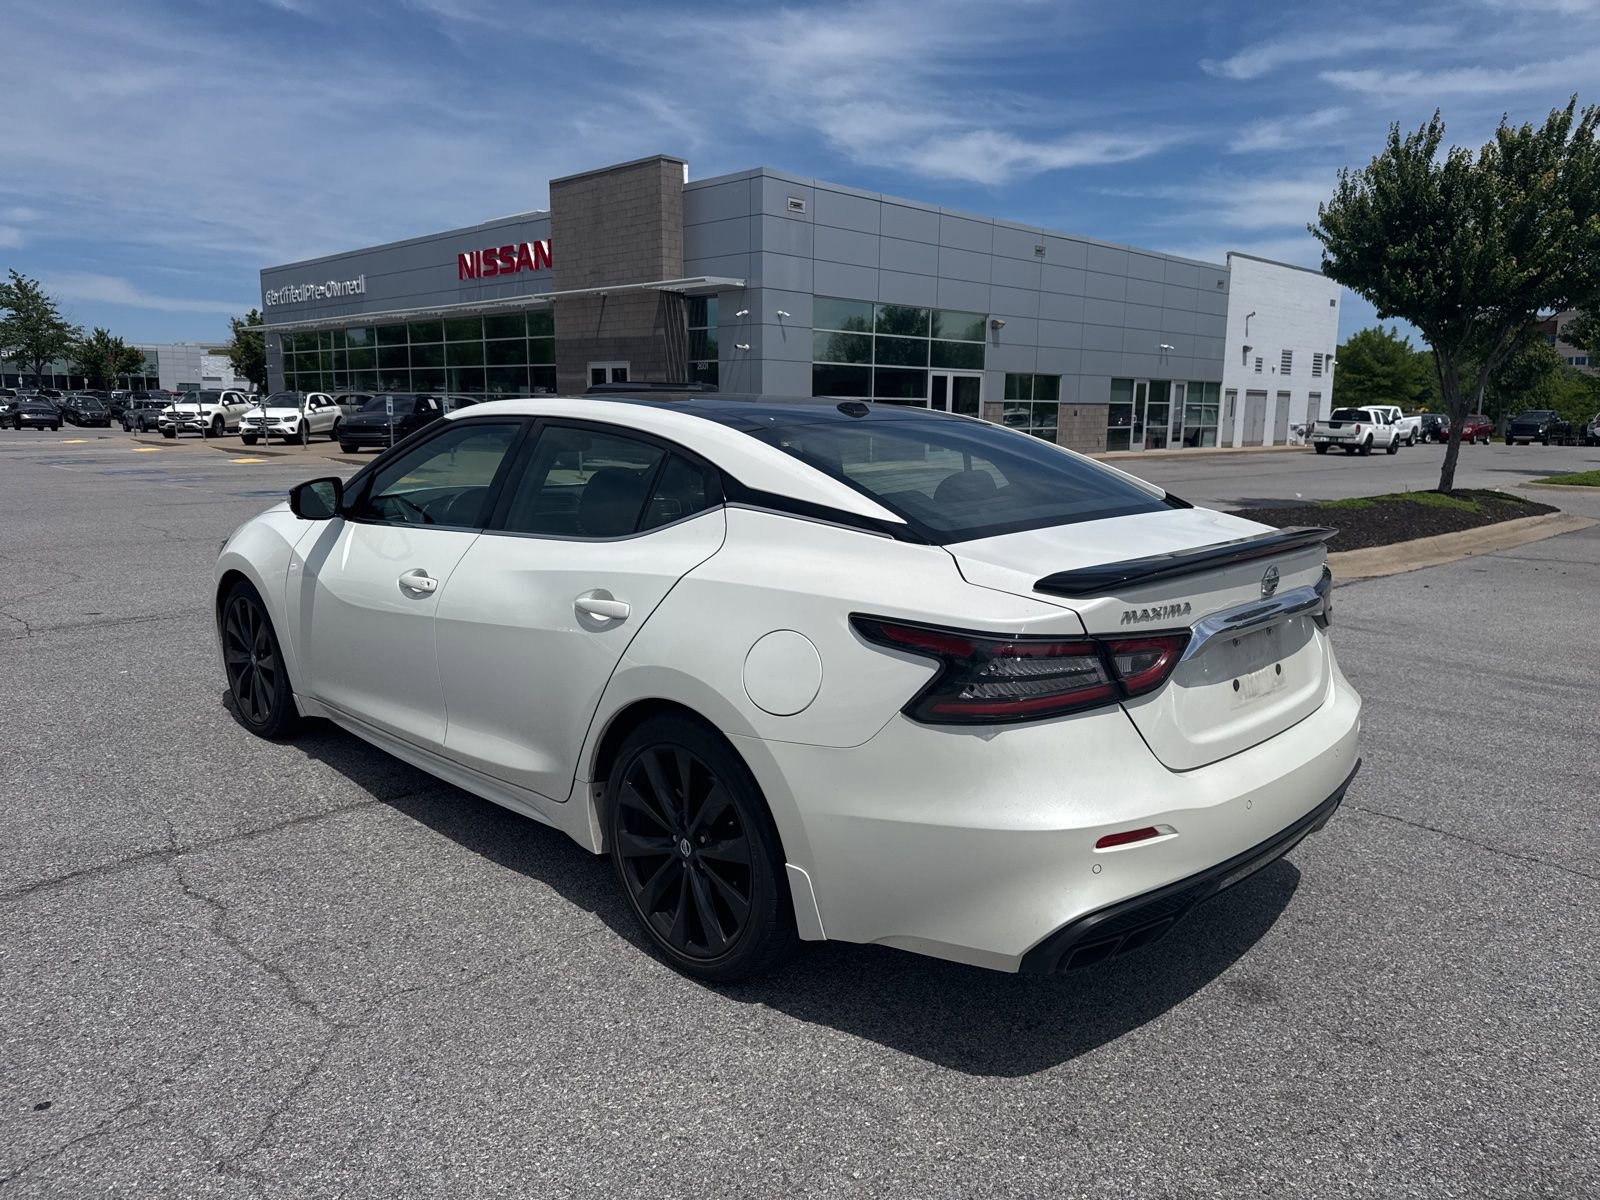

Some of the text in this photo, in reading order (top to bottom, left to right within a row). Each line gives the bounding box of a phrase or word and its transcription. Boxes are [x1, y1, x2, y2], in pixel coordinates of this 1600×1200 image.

[458, 239, 552, 280] NISSAN
[265, 274, 365, 306] Certified Pre-Owned
[1120, 602, 1192, 625] MAXIMA
